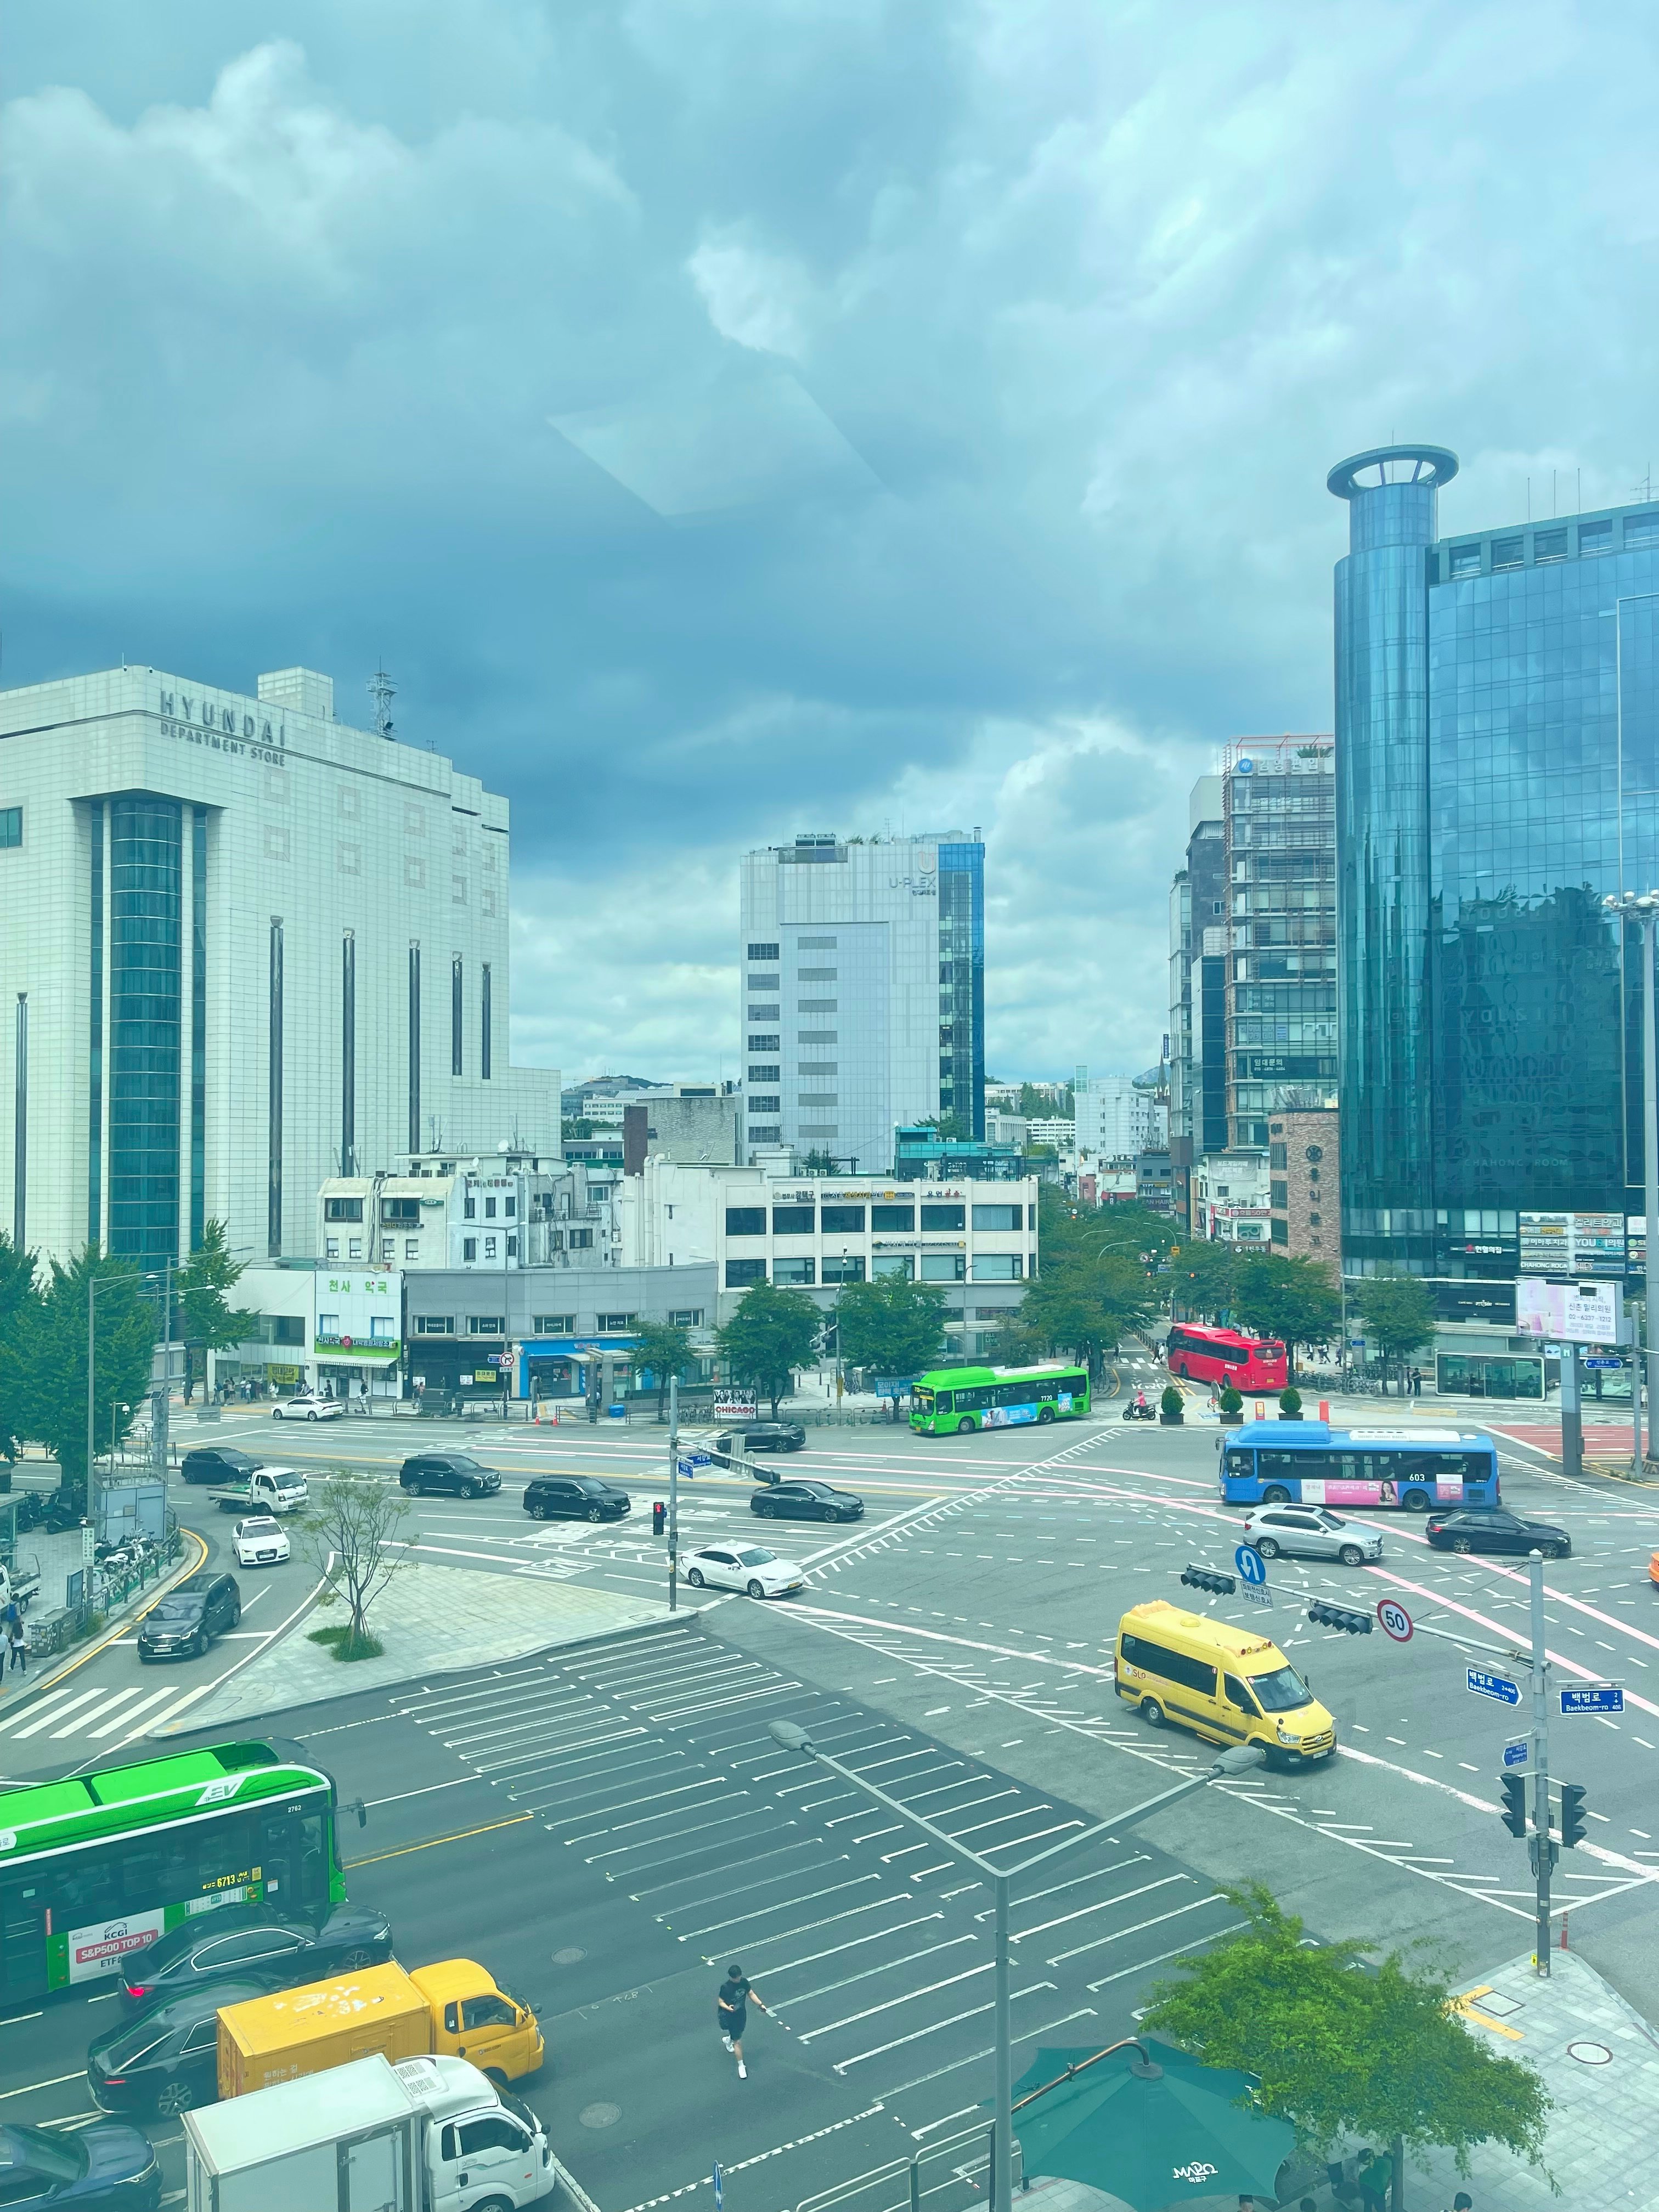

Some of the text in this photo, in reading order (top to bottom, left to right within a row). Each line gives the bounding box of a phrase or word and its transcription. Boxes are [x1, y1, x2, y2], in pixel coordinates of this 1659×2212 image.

[160, 690, 285, 746] HYUNDAI
[161, 723, 286, 766] DEPARTMENT STORE
[889, 877, 936, 888] U-PLEX
[1575, 1217, 1622, 1228] 엘리트안과
[329, 1280, 387, 1294] 천사 약국
[1386, 1610, 1404, 1631] 50
[1133, 1669, 1146, 1680] SLP
[1469, 1671, 1494, 1688] 백범로
[1469, 1682, 1509, 1701] Baekbeom-ro
[1571, 1692, 1601, 1703] 백범로
[208, 1783, 238, 1801] EV
[287, 1804, 302, 1814] 2762
[0, 1838, 10, 1848] 로
[217, 1874, 235, 1888] 6713
[104, 1928, 127, 1940] KCGI
[81, 1934, 152, 1960] S&P500 TOP 10
[1188, 2175, 1207, 2183] 마포구
